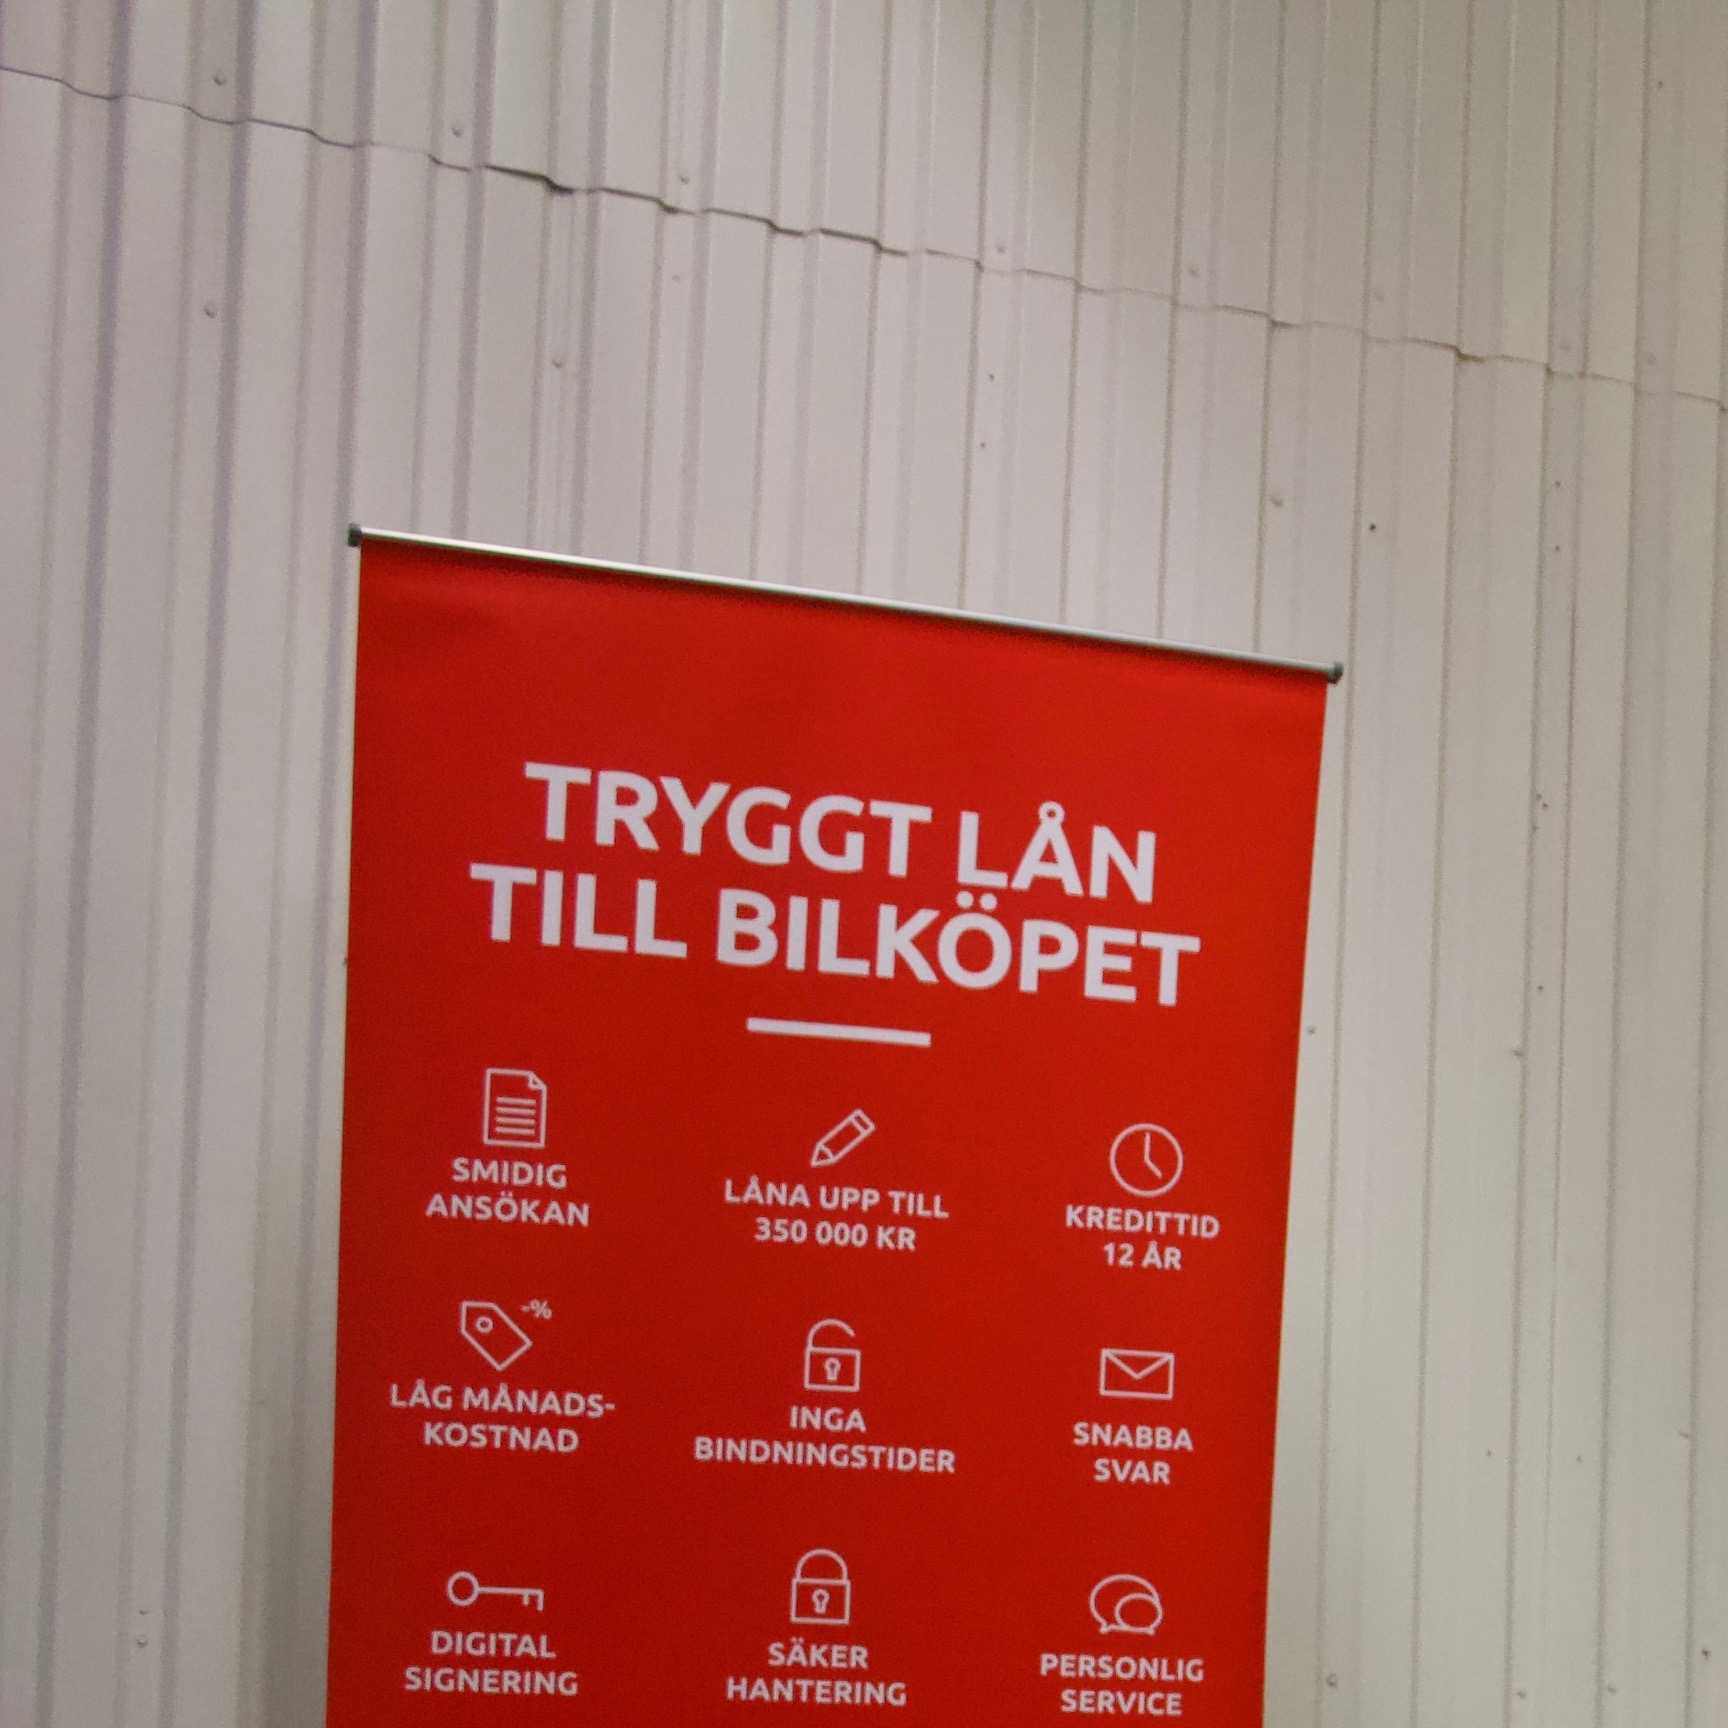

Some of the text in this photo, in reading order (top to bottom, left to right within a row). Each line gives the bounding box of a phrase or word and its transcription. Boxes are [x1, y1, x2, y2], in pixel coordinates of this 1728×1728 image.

[525, 763, 1155, 903] TRYGGT LÅN
[471, 863, 1200, 1006] TILL BILKÖPET
[453, 1158, 566, 1189] SMIDIG
[426, 1191, 589, 1226] ANSÖKAN
[725, 1176, 949, 1218] LÅNA UPP TILL
[755, 1217, 915, 1250] 350 000 KR
[1066, 1205, 1219, 1238] KREDITTID
[1104, 1241, 1181, 1270] 12 ÅR
[391, 1378, 615, 1418] LÅG MÅNADS-
[791, 1406, 866, 1432] INGA
[425, 1422, 578, 1452] KOSTNAD
[1074, 1422, 1193, 1451] SNABBA
[695, 1437, 955, 1473] BINDNINGSTIDER
[1095, 1458, 1170, 1484] SVAR
[432, 1631, 556, 1658] DIGITAL
[769, 1638, 868, 1668] SÄKER
[405, 1667, 577, 1695] SIGNERING
[1041, 1653, 1203, 1682] PERSONLIG
[727, 1677, 906, 1706] HANTERING
[1061, 1689, 1181, 1715] SERVICE
